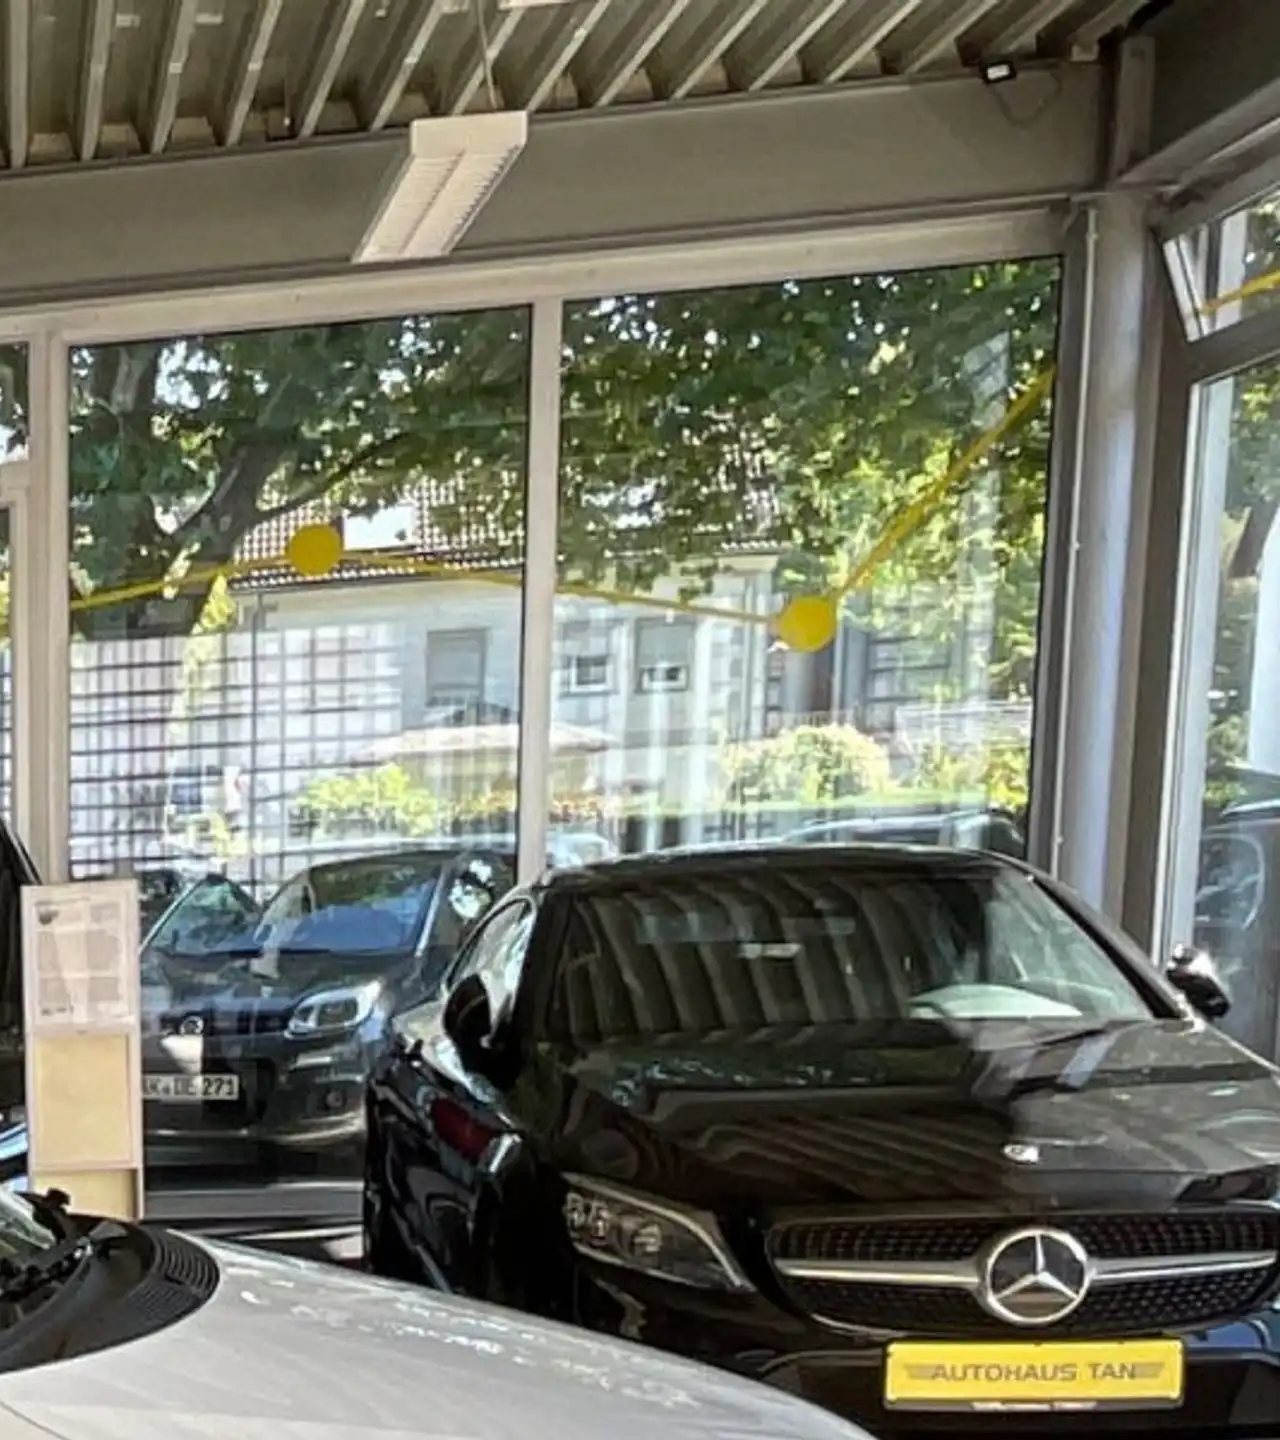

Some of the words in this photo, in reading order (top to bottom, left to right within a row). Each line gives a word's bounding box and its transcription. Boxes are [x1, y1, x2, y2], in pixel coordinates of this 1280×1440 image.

[202, 1077, 234, 1096] 271
[930, 1362, 1077, 1382] AUTOHAUS
[1088, 1362, 1137, 1381] TAN
